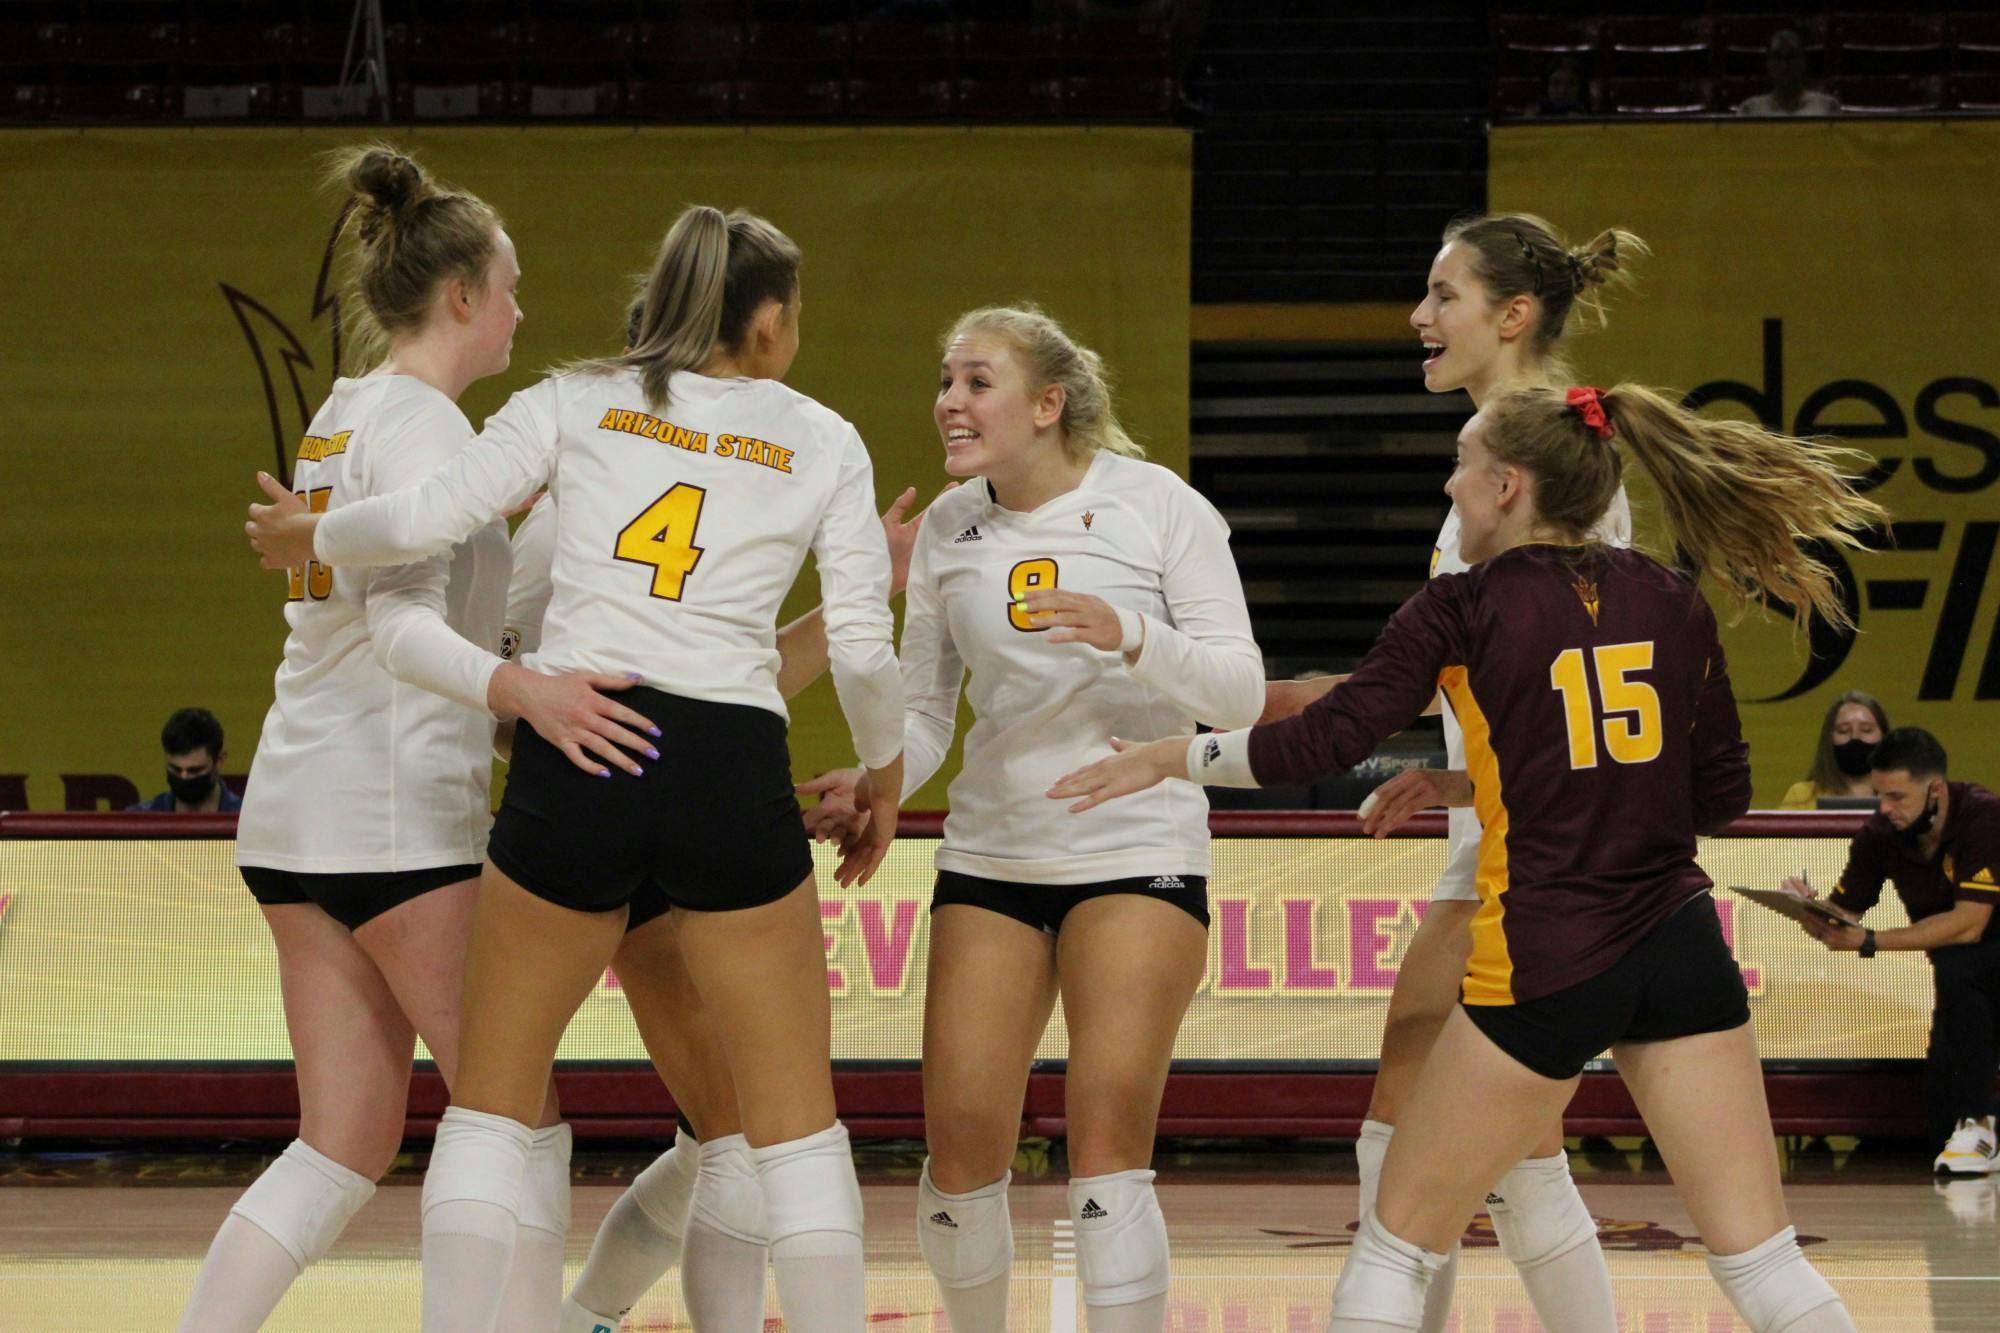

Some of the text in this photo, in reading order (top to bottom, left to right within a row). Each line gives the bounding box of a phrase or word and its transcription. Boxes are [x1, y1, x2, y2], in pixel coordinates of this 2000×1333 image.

[599, 407, 795, 474] ARIZONA STATE
[612, 481, 708, 603] 4
[954, 534, 983, 544] adidas
[1007, 557, 1059, 632] 9
[1550, 641, 1663, 770] 15
[1148, 879, 1186, 889] adidas
[1081, 1208, 1108, 1220] adidas
